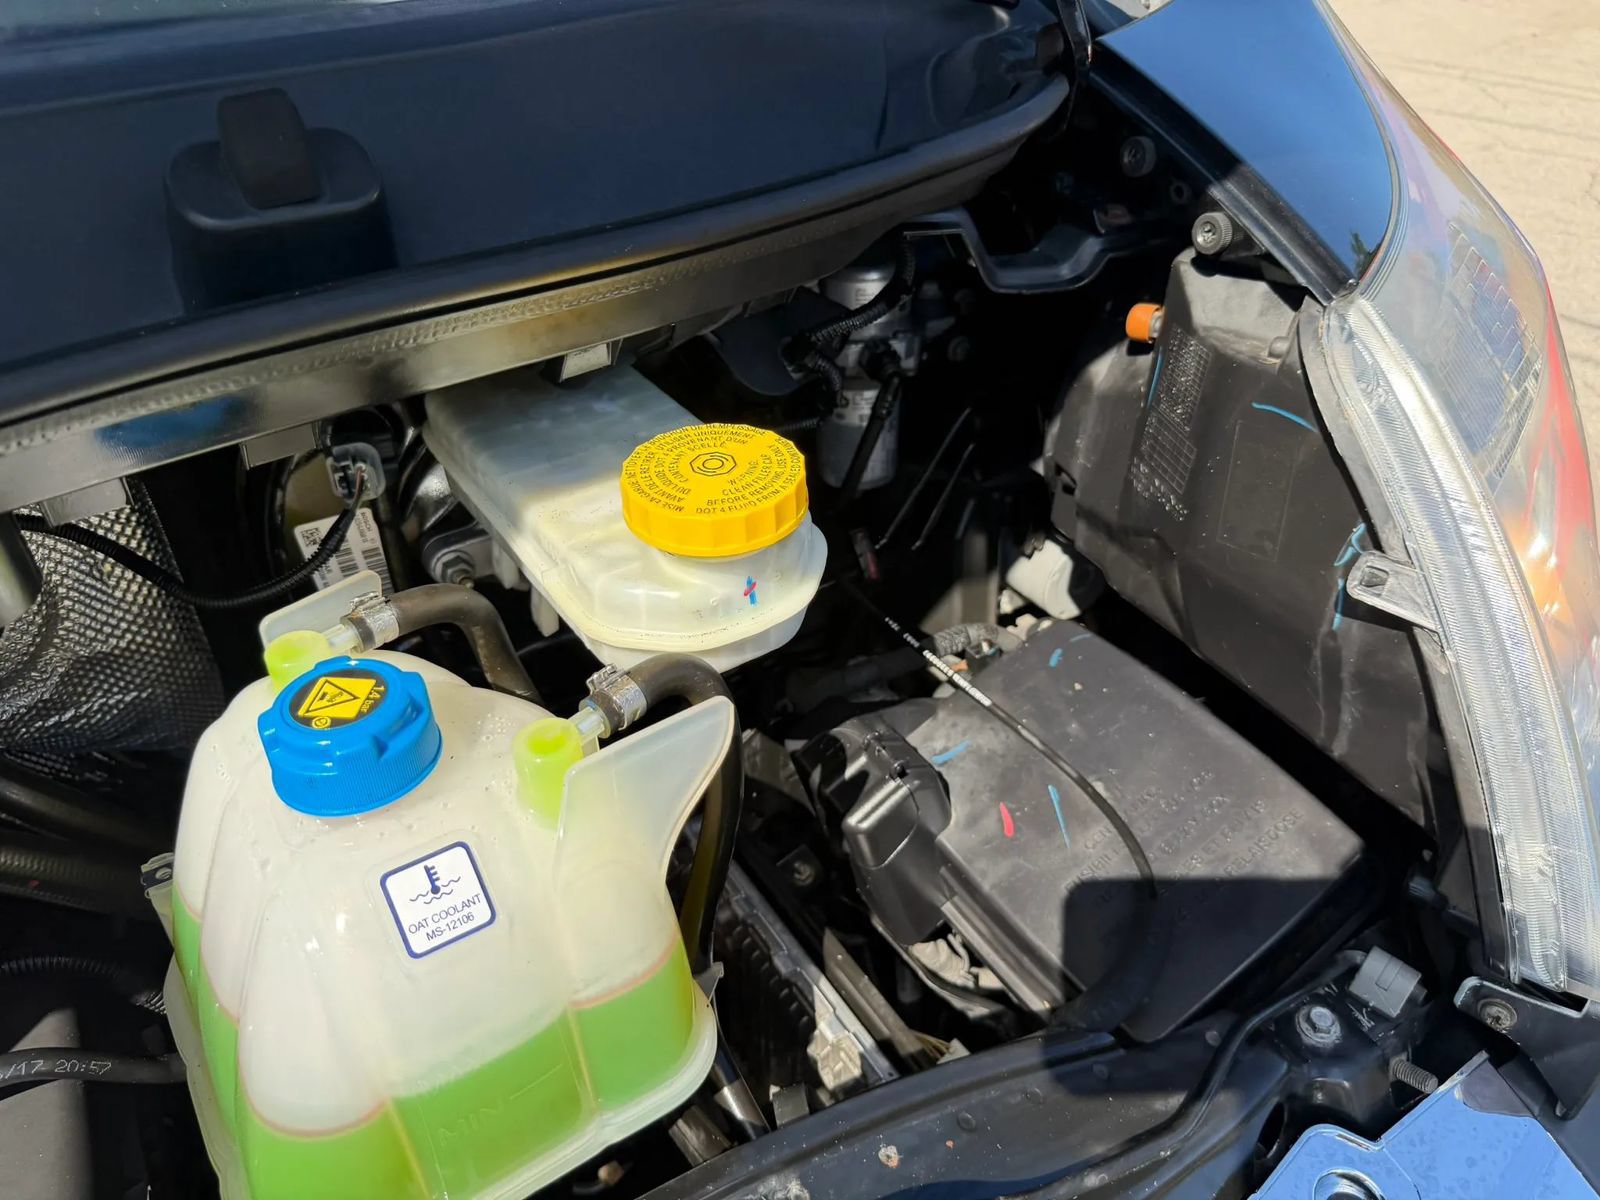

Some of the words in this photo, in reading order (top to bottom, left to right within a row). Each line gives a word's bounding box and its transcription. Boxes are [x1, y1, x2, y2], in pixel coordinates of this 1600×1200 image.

[667, 436, 721, 452] PROVENANT
[655, 489, 685, 502] AVANT
[694, 430, 754, 439] UNIQUEMENT
[707, 494, 748, 506] BEFORE
[777, 458, 787, 469] USE
[722, 482, 754, 496] CLEAN
[752, 465, 771, 484] FILLER
[677, 487, 691, 495] DU
[757, 488, 780, 503] FROM
[662, 502, 685, 512] MISE
[361, 699, 375, 713] bar
[408, 917, 430, 935] OAT
[431, 893, 481, 923] COOLANT
[426, 911, 475, 941] MS-12106
[54, 1059, 112, 1076] 20:57
